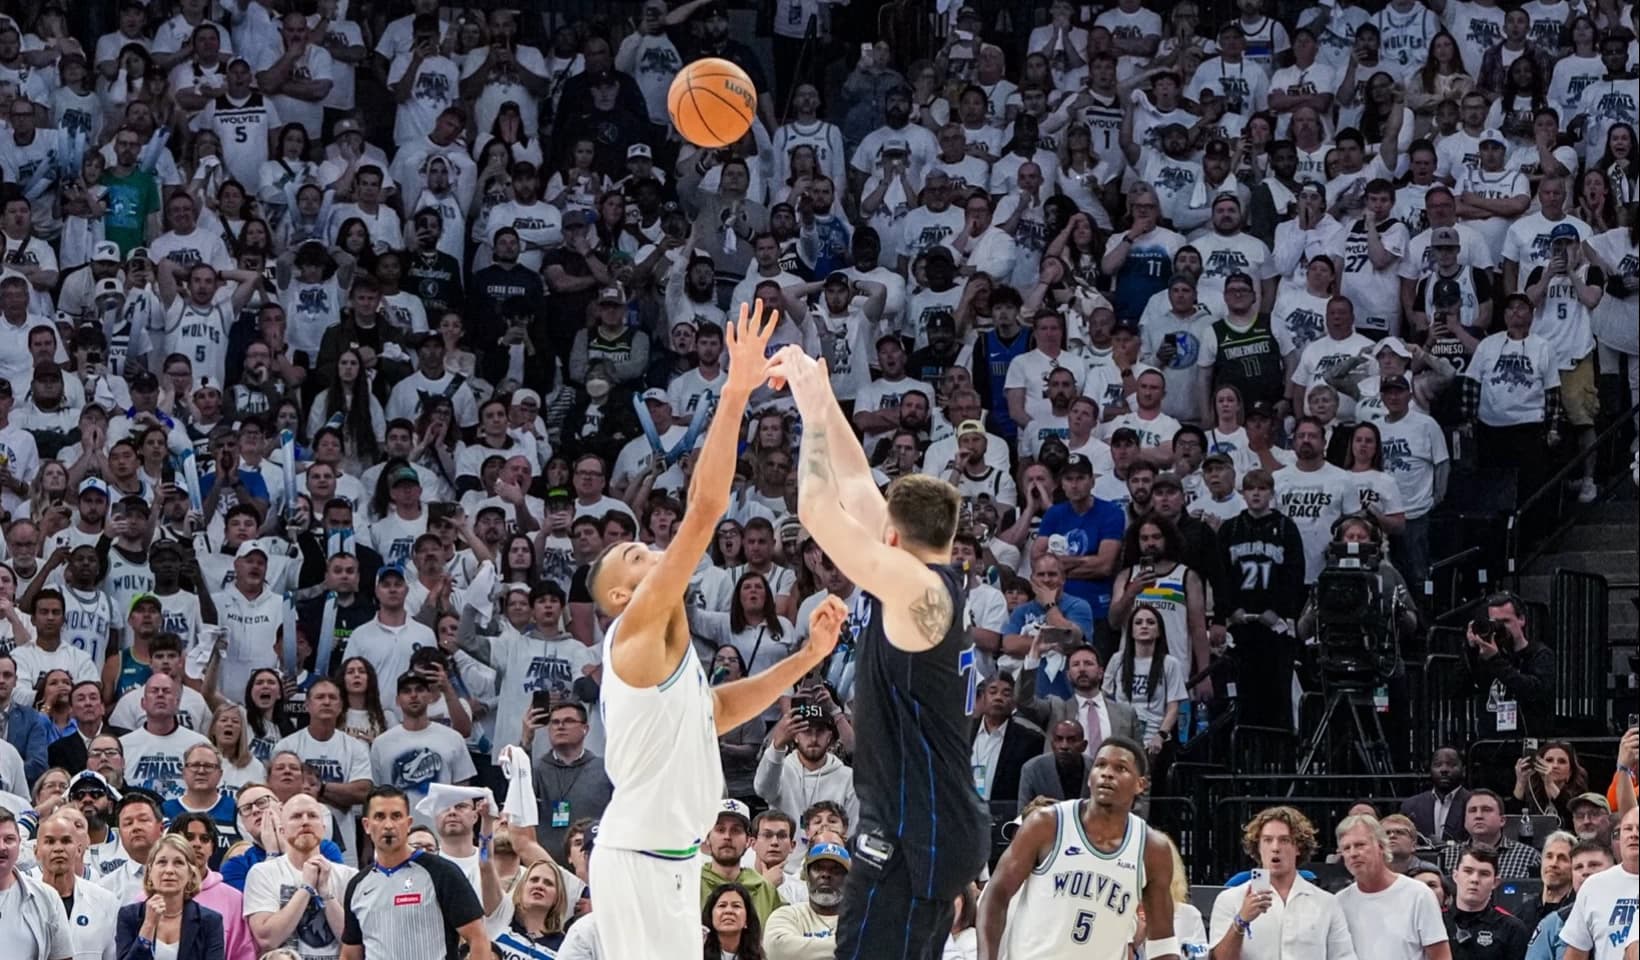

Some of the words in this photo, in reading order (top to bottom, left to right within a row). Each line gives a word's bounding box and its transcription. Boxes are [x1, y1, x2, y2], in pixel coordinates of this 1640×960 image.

[1399, 50, 1408, 65] 3
[220, 114, 261, 124] WOLVES
[235, 127, 248, 143] 5
[1148, 260, 1162, 277] 11
[1345, 256, 1369, 273] 27
[1557, 303, 1567, 319] 5
[182, 323, 221, 345] WOLVES
[196, 346, 206, 364] 5
[1492, 359, 1533, 375] FINALS
[1288, 505, 1322, 517] BACK
[1240, 561, 1272, 590] 21
[526, 662, 573, 682] FINALS
[132, 762, 184, 780] FINALS
[1053, 870, 1131, 915] WOLVES
[1071, 908, 1097, 945] 5
